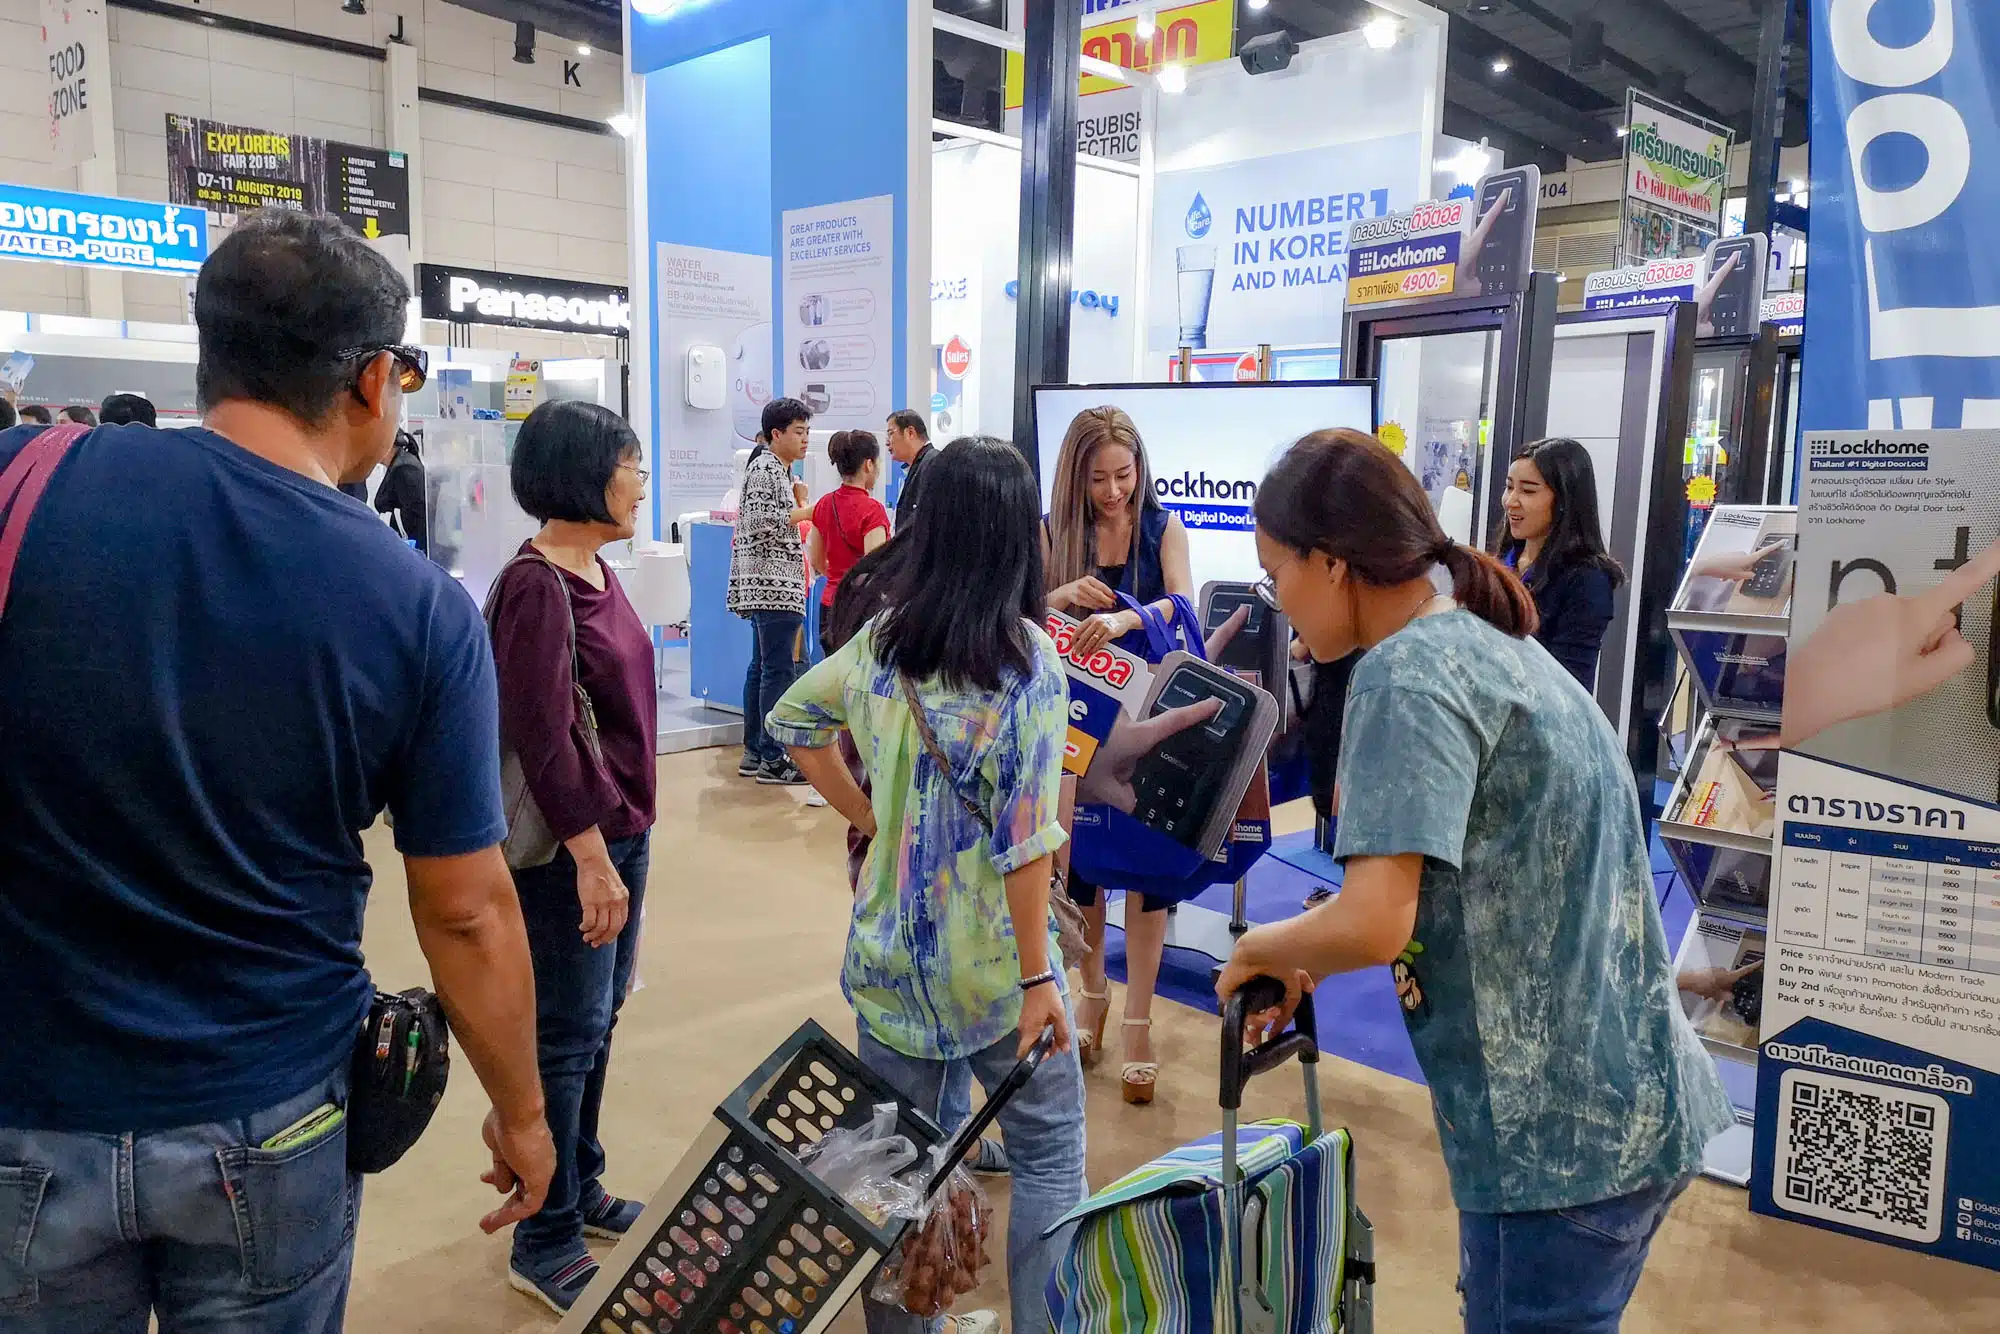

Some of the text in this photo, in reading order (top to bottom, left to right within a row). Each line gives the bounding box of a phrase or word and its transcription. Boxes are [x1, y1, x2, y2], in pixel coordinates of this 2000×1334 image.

[389, 15, 403, 41] J
[50, 42, 85, 83] FOOD
[563, 60, 581, 88] K
[53, 79, 87, 121] ZONE
[206, 131, 290, 156] EXPLORERS
[222, 154, 277, 169] FAIR 2019
[348, 157, 376, 169] ADVENTURE
[348, 167, 366, 177] TRAVEL
[197, 172, 302, 200] 07-11 AUGUST 2019
[348, 176, 368, 187] GADGET
[1540, 183, 1568, 198] 104
[349, 196, 396, 210] OUTDOOR LIFESTYLE
[350, 206, 379, 217] FOOD TRUCK
[1235, 192, 1365, 234] NUMBER
[790, 216, 857, 235] GREAT PRODUCTS
[790, 228, 864, 248] ARE GREATER WITH
[790, 242, 871, 261] EXCELLENT SERVICES
[1234, 240, 1260, 265] IN
[1373, 245, 1447, 271] Lockhome
[666, 256, 702, 270] WATER
[666, 267, 720, 282] SOFTENER
[1232, 271, 1276, 291] AND
[1357, 282, 1399, 298] ราคาเพียง
[669, 449, 699, 460] BIDET
[1829, 439, 1930, 455] Lockhome
[1811, 460, 1845, 469] Thailand
[1847, 460, 1860, 468] #1
[1861, 460, 1886, 470] Digital
[1154, 470, 1258, 500] ockhom
[1917, 477, 1932, 486] Life
[1935, 476, 1956, 487] Style
[1723, 511, 1762, 522] Lockhome
[1894, 503, 1920, 514] Digital
[1923, 504, 1944, 513] Door
[1946, 503, 1966, 513] Lock
[1184, 510, 1218, 526] Digital
[1826, 516, 1866, 525] Lockhome
[1787, 794, 1966, 831] ตารางราคา
[1840, 862, 1861, 870] Inspire
[1945, 855, 1961, 864] Price
[1838, 886, 1860, 895] Motion
[1942, 893, 1959, 902] 7900
[1780, 948, 1804, 959] Price
[1918, 968, 1955, 982] Modern
[1960, 975, 1985, 986] Trade
[1778, 977, 1797, 990] Buy
[1801, 981, 1820, 992] 2nd
[1780, 963, 1794, 973] On
[1798, 966, 1814, 976] Pro
[1872, 977, 1919, 993] Promotion
[1777, 992, 1800, 1004] Pack
[1803, 997, 1815, 1006] of
[1818, 999, 1825, 1008] 5
[1901, 1012, 1908, 1022] 5
[1767, 1043, 1969, 1094] ดาวน์โหลดแคตตาล็อก
